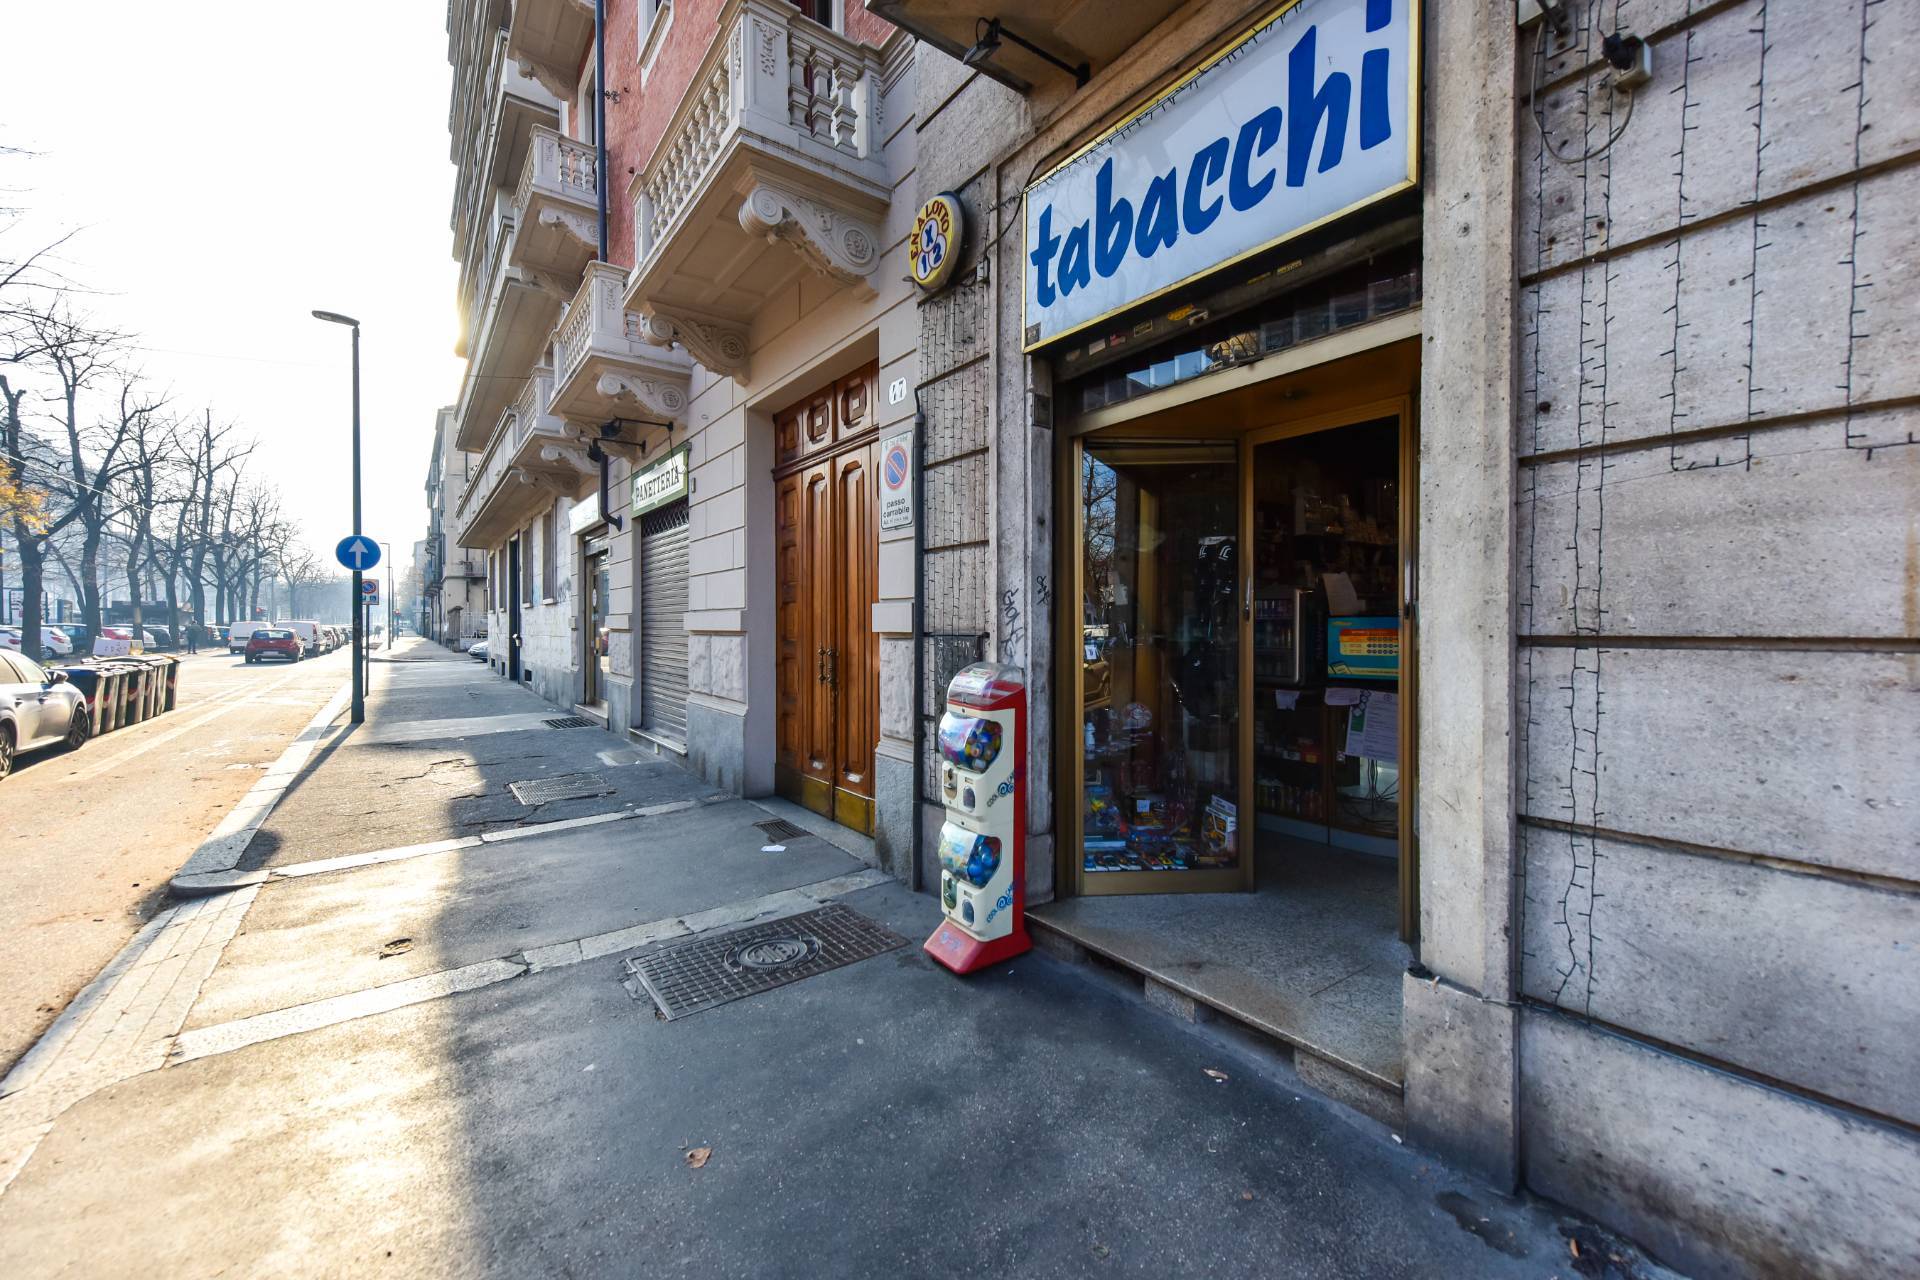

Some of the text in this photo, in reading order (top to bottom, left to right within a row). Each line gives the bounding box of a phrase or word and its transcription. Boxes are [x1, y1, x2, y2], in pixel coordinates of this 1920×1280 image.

[1030, 0, 1393, 308] tabacchi
[932, 241, 943, 265] 2
[635, 465, 680, 504] PANETTERIA
[882, 505, 910, 519] carrabile
[886, 498, 906, 510] passo
